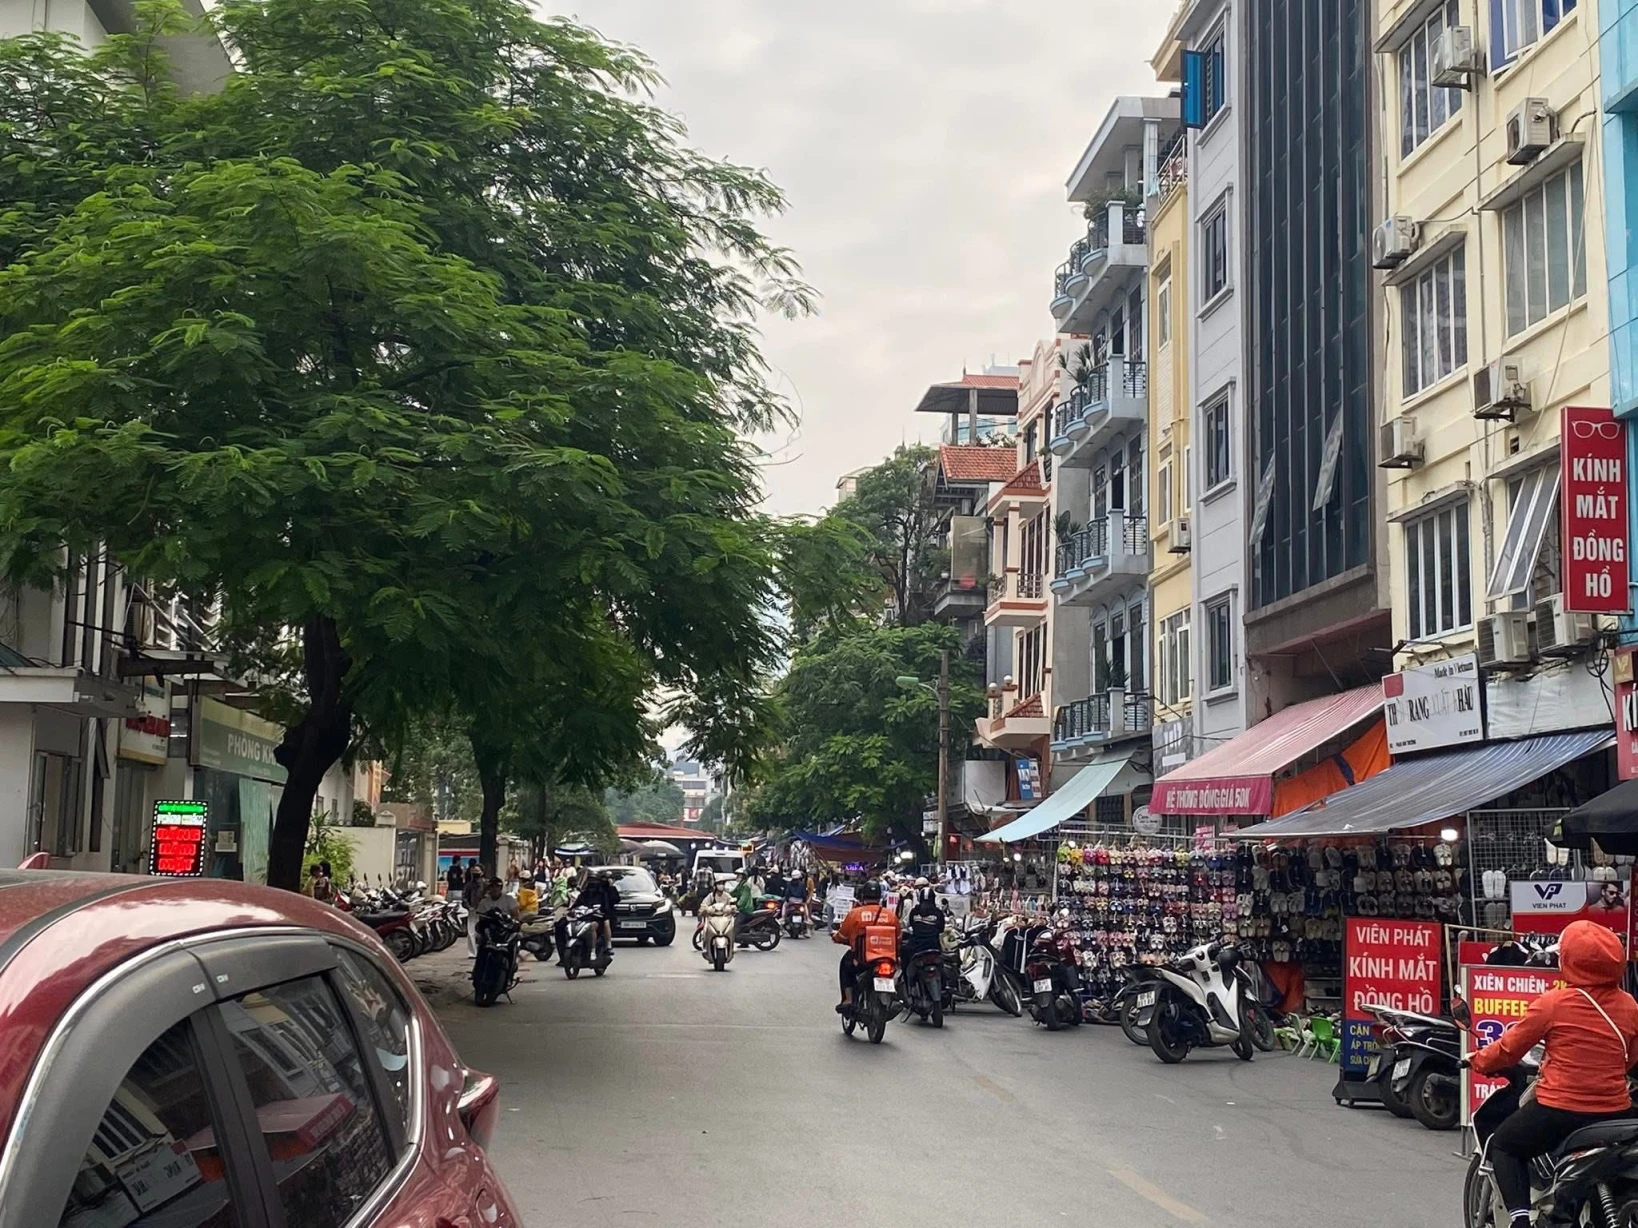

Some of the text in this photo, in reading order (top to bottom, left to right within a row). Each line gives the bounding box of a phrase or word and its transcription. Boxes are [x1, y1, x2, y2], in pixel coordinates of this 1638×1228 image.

[1573, 453, 1621, 483] KÍNH
[1576, 486, 1619, 519] MẮT
[1573, 529, 1624, 562] ĐỒNG
[1585, 566, 1612, 598] HỒ
[1622, 682, 1638, 731] KÍ
[227, 732, 260, 761] PHÒNG
[1534, 883, 1562, 900] VP
[1356, 923, 1432, 947] VIÊN PHÁT
[1350, 952, 1437, 981] KÍNH MẮT
[1474, 973, 1504, 991] XIÊN
[1507, 976, 1549, 994] CHIÊN:
[1353, 984, 1433, 1014] ĐỒNG HỒ
[1350, 1025, 1370, 1038] CẬN
